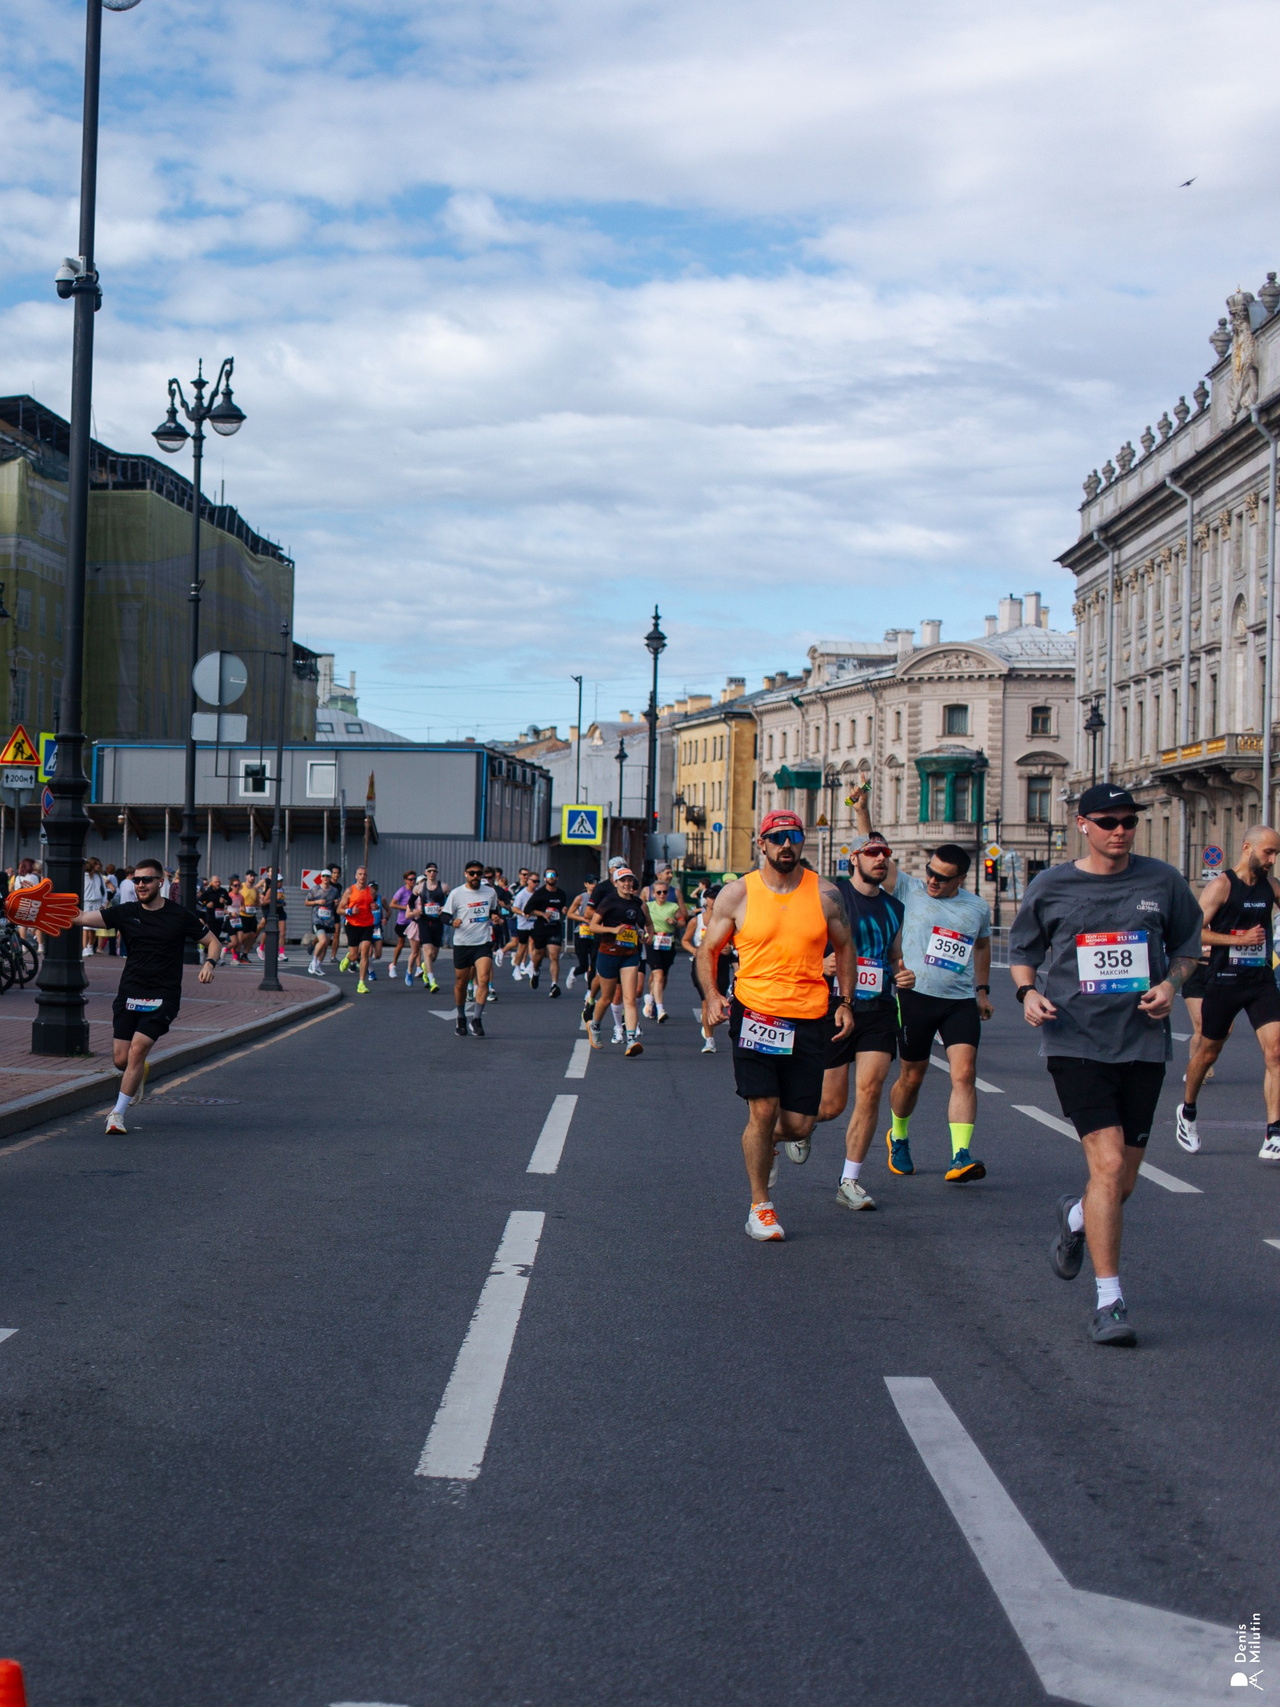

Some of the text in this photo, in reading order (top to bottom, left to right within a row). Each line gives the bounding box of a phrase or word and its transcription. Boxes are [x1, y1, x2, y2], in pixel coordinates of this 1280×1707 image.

[10, 774, 29, 783] 200м
[14, 897, 33, 923] FITNESS
[27, 899, 43, 923] DDX
[934, 938, 966, 957] 3598
[928, 956, 936, 964] D
[1093, 949, 1133, 969] 358
[857, 972, 877, 986] 03
[1086, 981, 1096, 992] D
[748, 1023, 785, 1042] 4701
[745, 1039, 753, 1047] D
